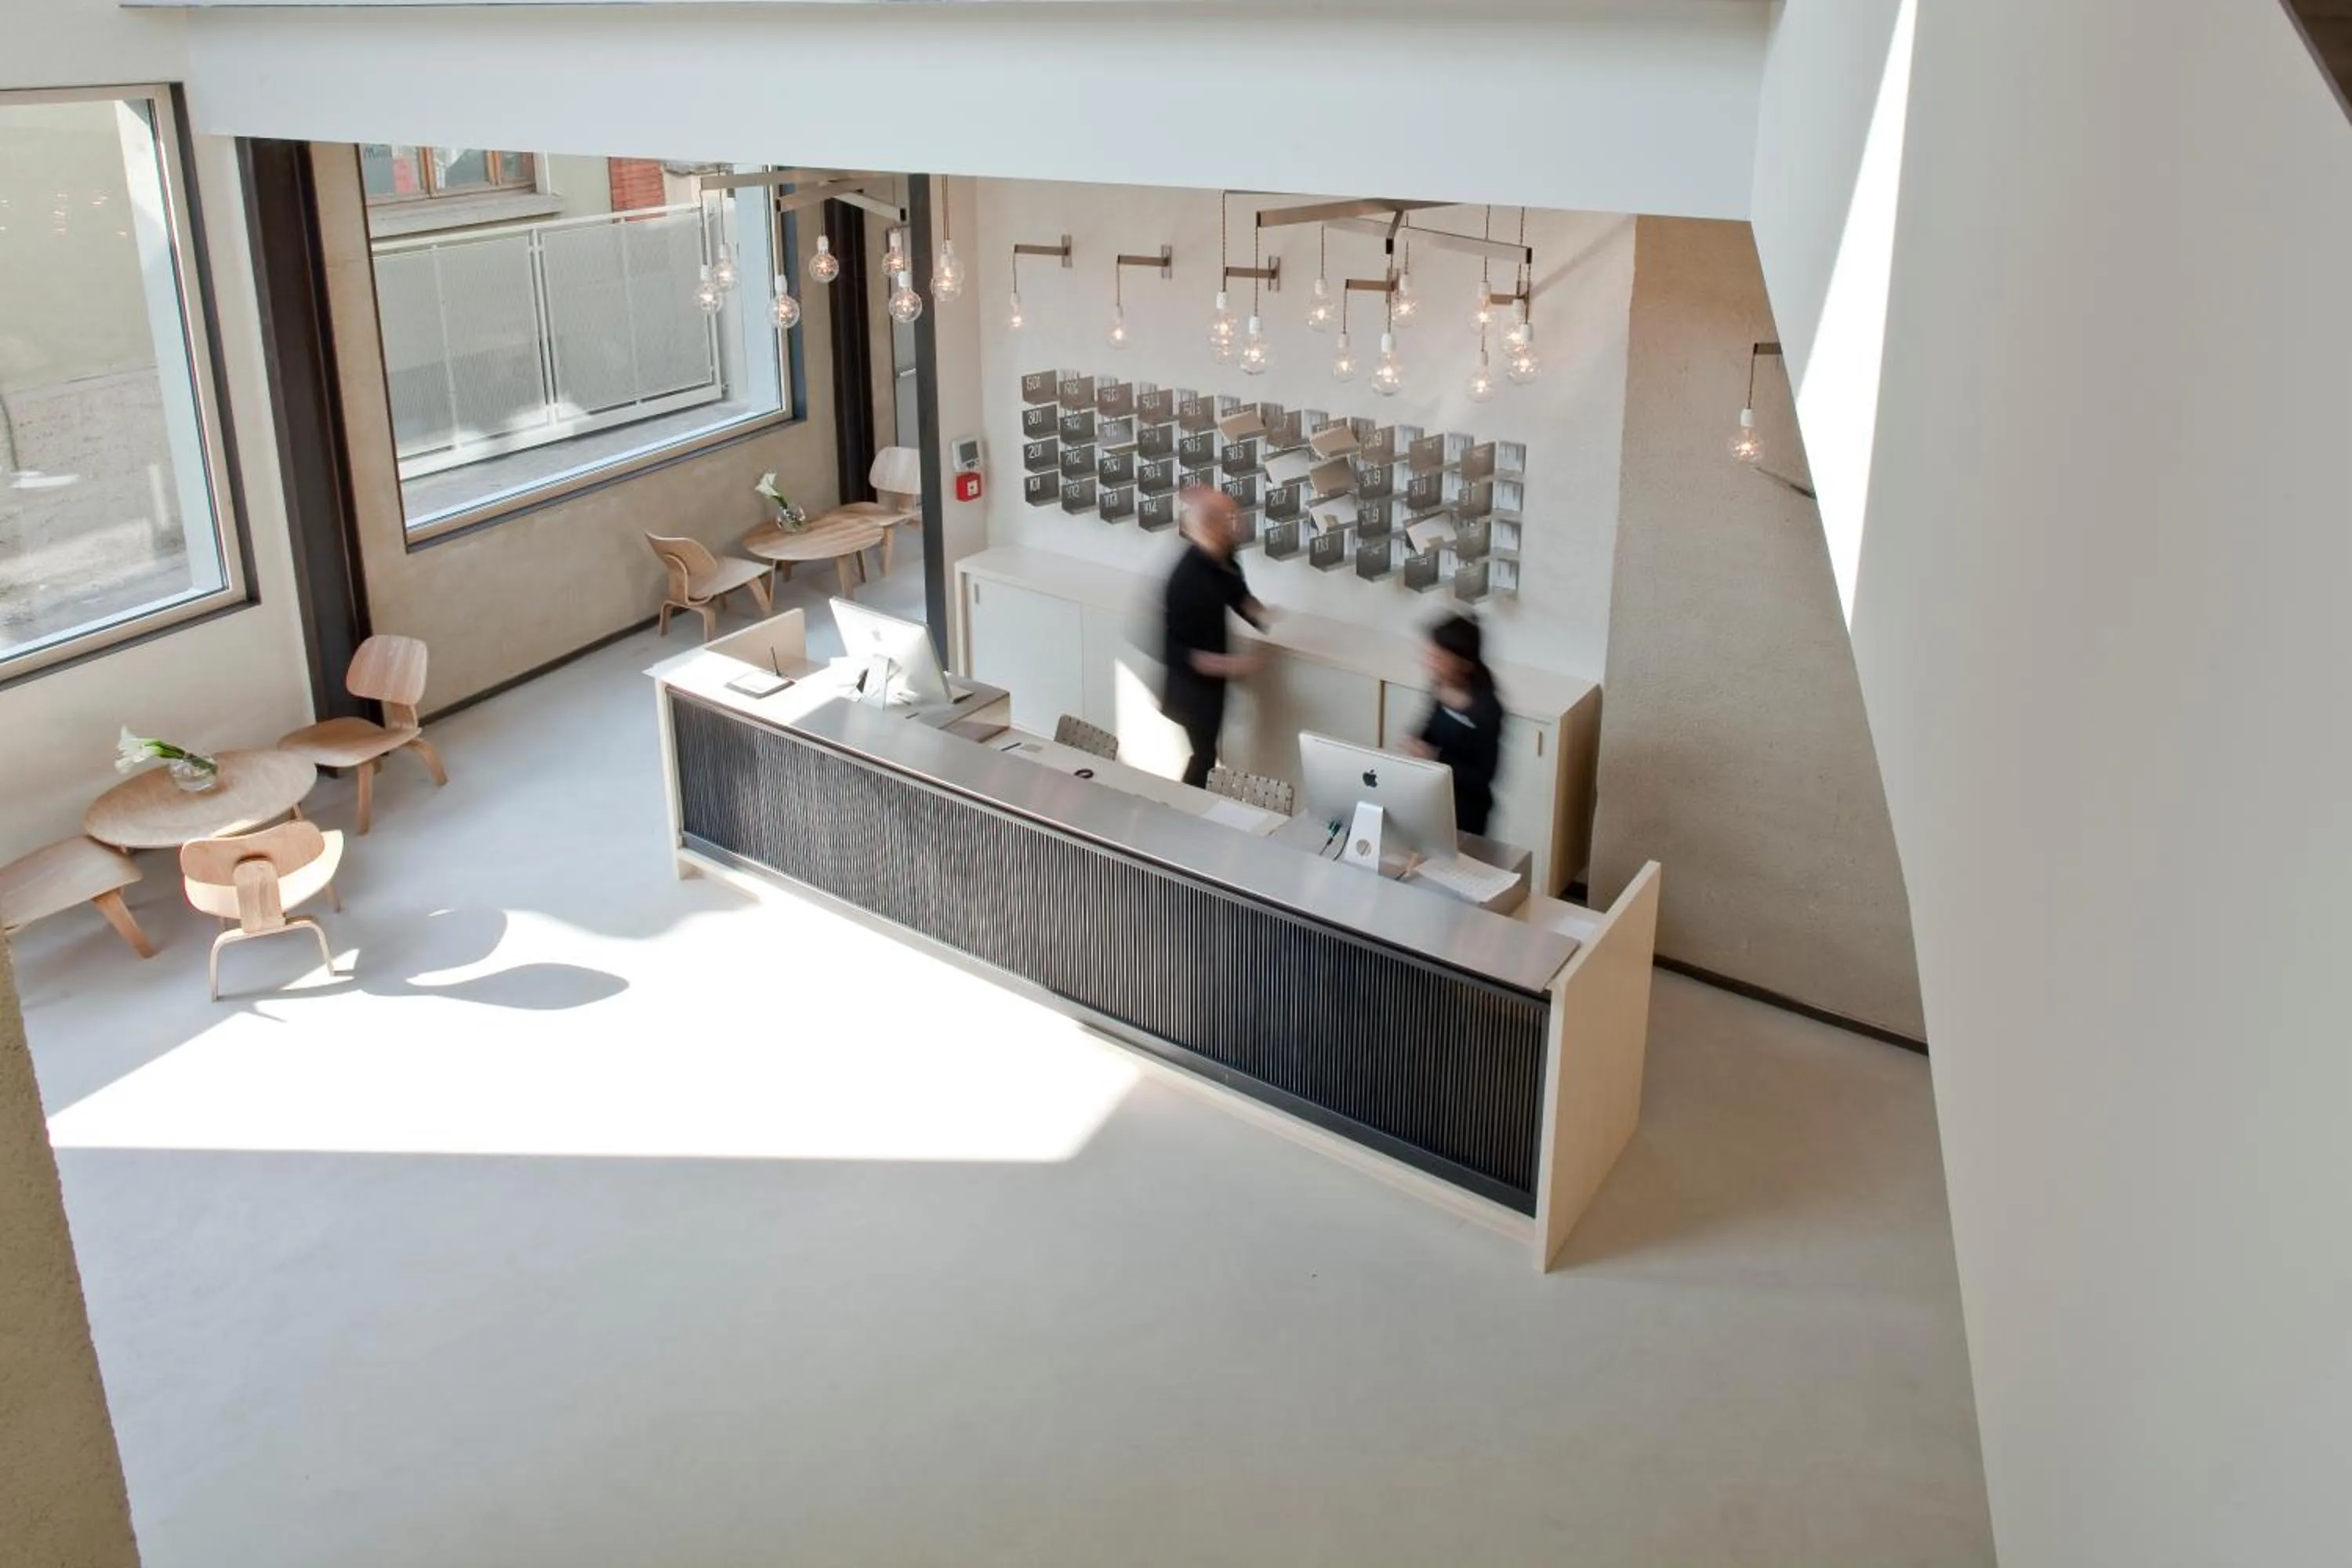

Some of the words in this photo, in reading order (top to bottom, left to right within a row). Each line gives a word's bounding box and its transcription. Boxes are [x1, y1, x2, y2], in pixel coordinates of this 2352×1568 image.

[1028, 410, 1042, 425] 301
[1028, 443, 1041, 459] 201
[1029, 476, 1040, 492] 101
